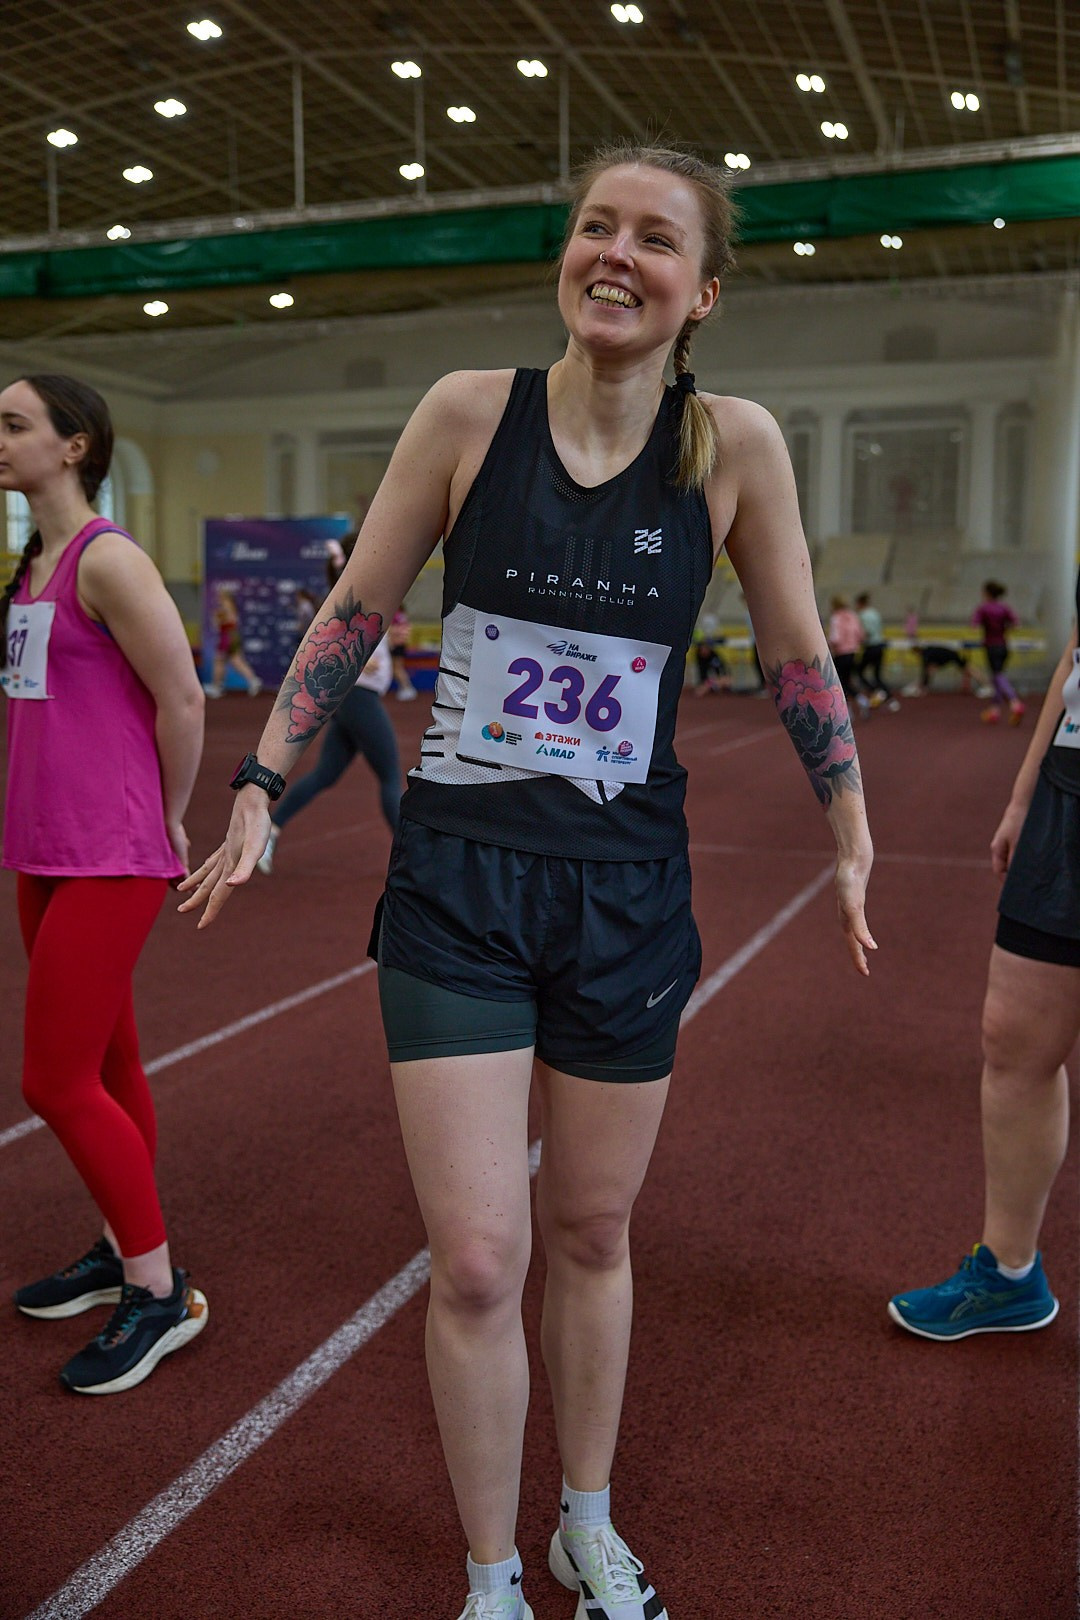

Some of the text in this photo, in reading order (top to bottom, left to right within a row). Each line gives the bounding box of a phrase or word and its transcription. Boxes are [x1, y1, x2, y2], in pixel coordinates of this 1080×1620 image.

[506, 569, 660, 598] PIRANHA
[528, 587, 634, 606] RUNNING CLUB
[568, 643, 580, 652] НА
[565, 650, 598, 663] ВИРАЖЕ
[502, 656, 622, 733] 236
[549, 747, 576, 760] MAD
